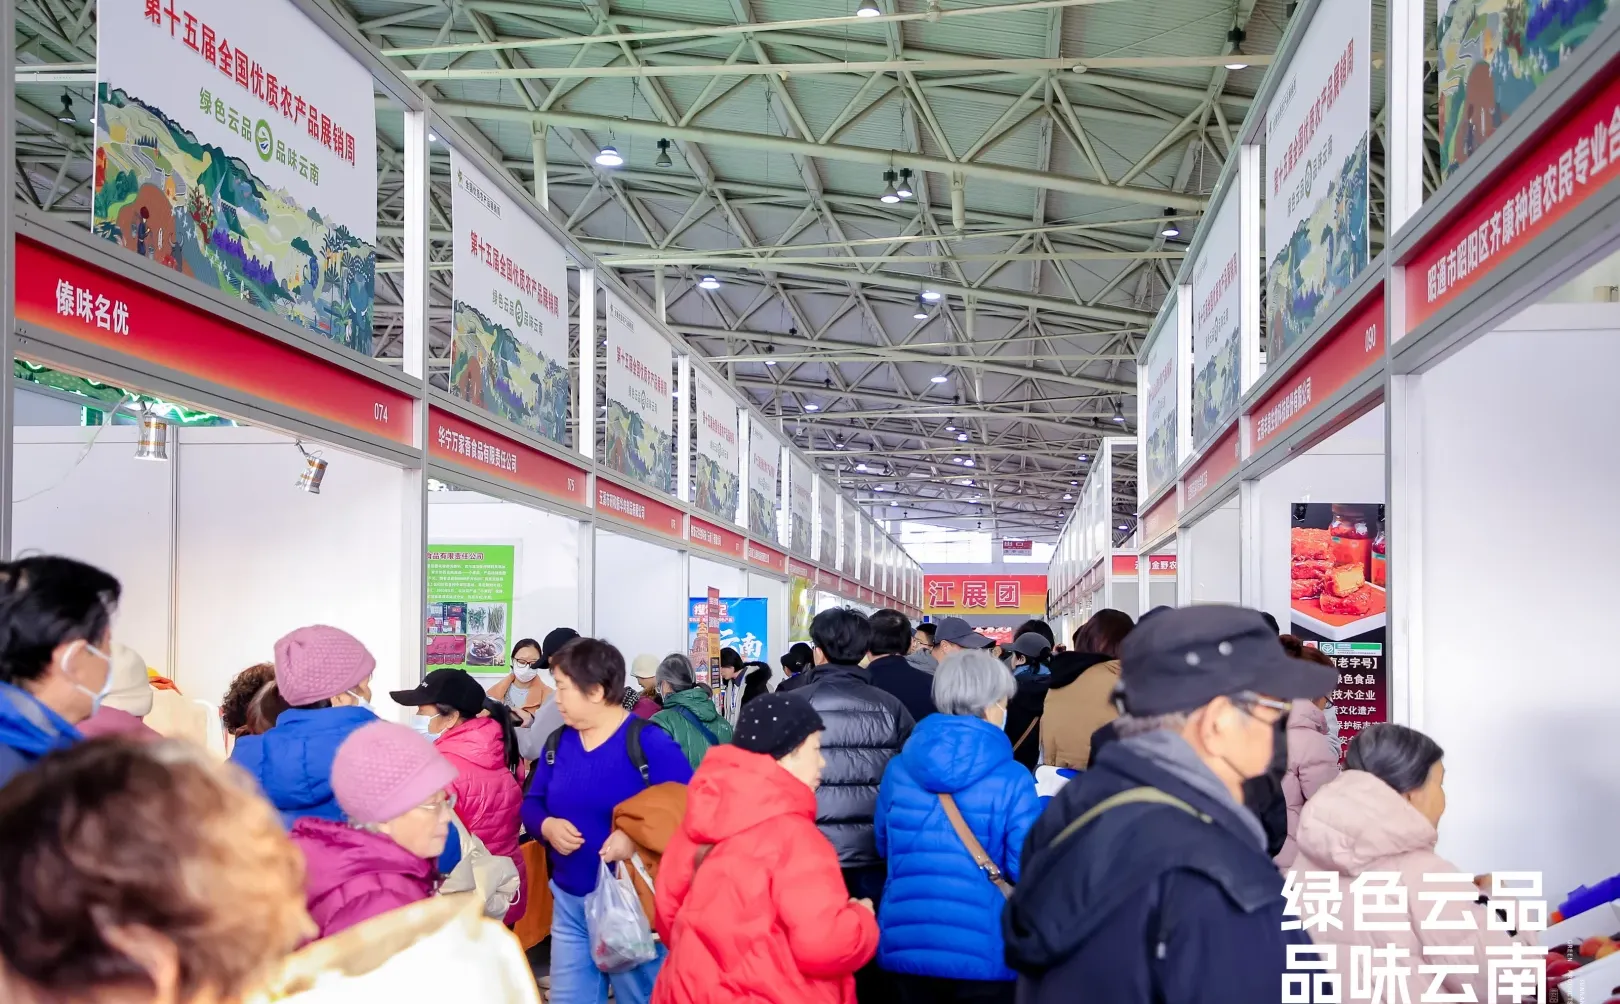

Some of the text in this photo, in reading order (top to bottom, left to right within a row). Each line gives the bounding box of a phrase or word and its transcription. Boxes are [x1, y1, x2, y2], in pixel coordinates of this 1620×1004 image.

[143, 0, 356, 167] 第十五届全国优质农产品展销周
[199, 86, 320, 186] 绿色云品 品味云南
[1273, 37, 1354, 198] 第十五届全国优质农产品展销周
[470, 230, 559, 318] 第十五届全国优质农产品展销周
[55, 278, 129, 337] 傣味名优
[1364, 323, 1376, 353] 090
[374, 401, 388, 423] 074
[438, 425, 517, 473] 华宁万家香食品有限责任公司
[929, 580, 1020, 608] 江展团
[1332, 689, 1376, 701] 技术企业
